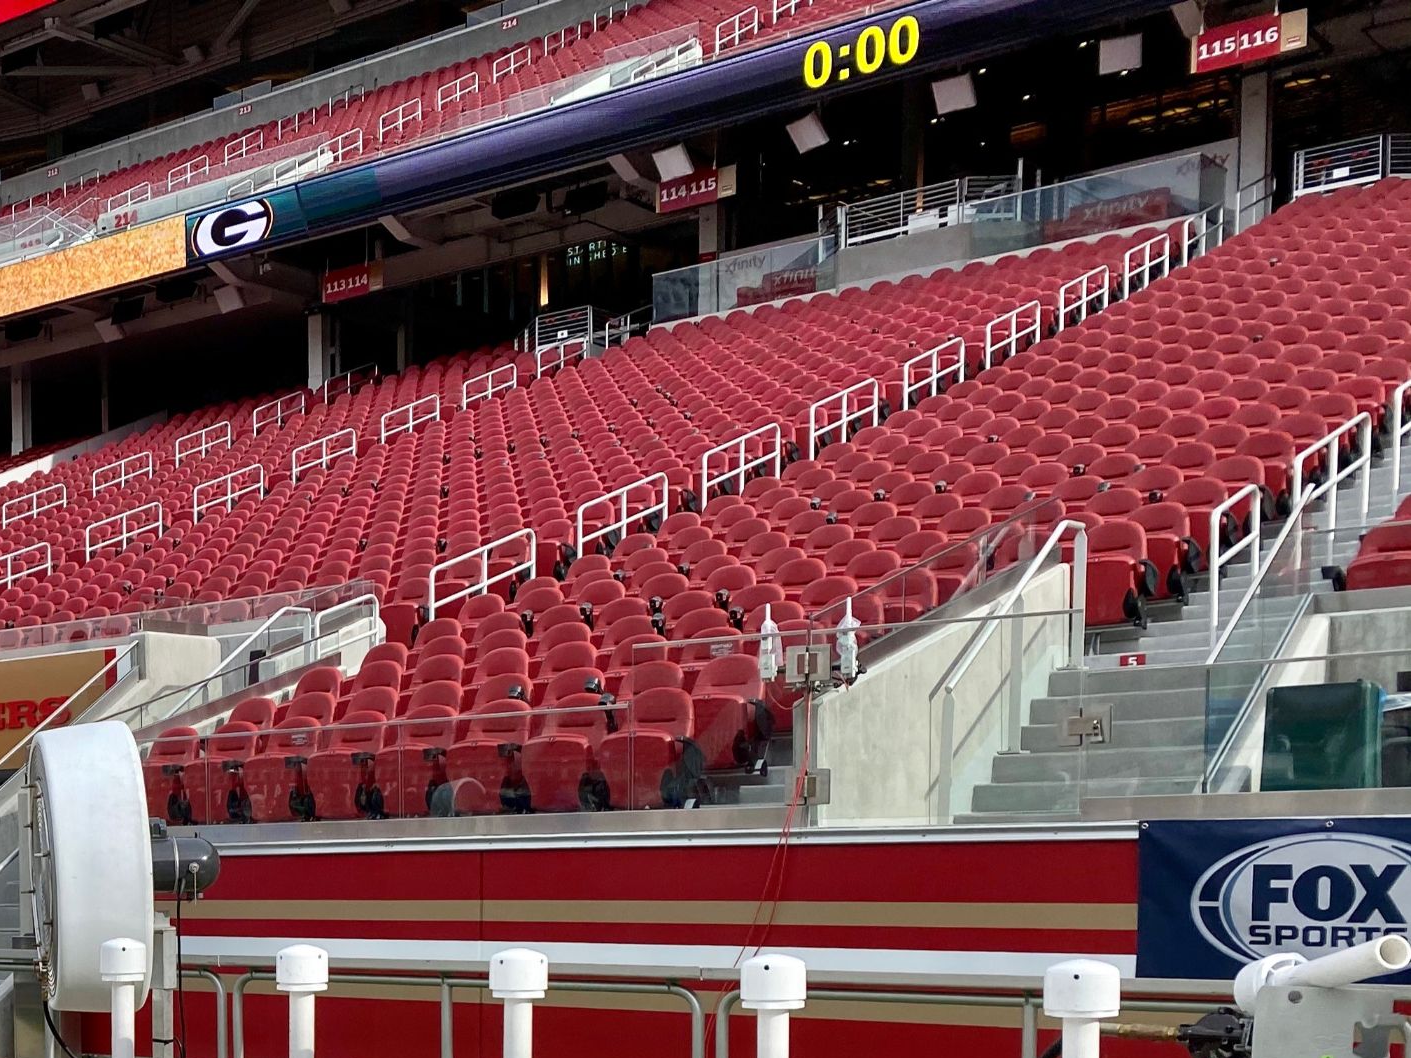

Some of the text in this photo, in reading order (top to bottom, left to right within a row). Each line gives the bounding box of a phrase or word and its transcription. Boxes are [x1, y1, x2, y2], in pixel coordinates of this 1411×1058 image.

[804, 15, 920, 88] 0:00
[1198, 36, 1237, 61] 115
[1239, 26, 1279, 50] 116
[660, 177, 717, 203] 114 115
[114, 208, 139, 229] 214
[724, 256, 766, 274] xfinity
[326, 273, 369, 294] 113 114
[1251, 863, 1409, 925] FOX
